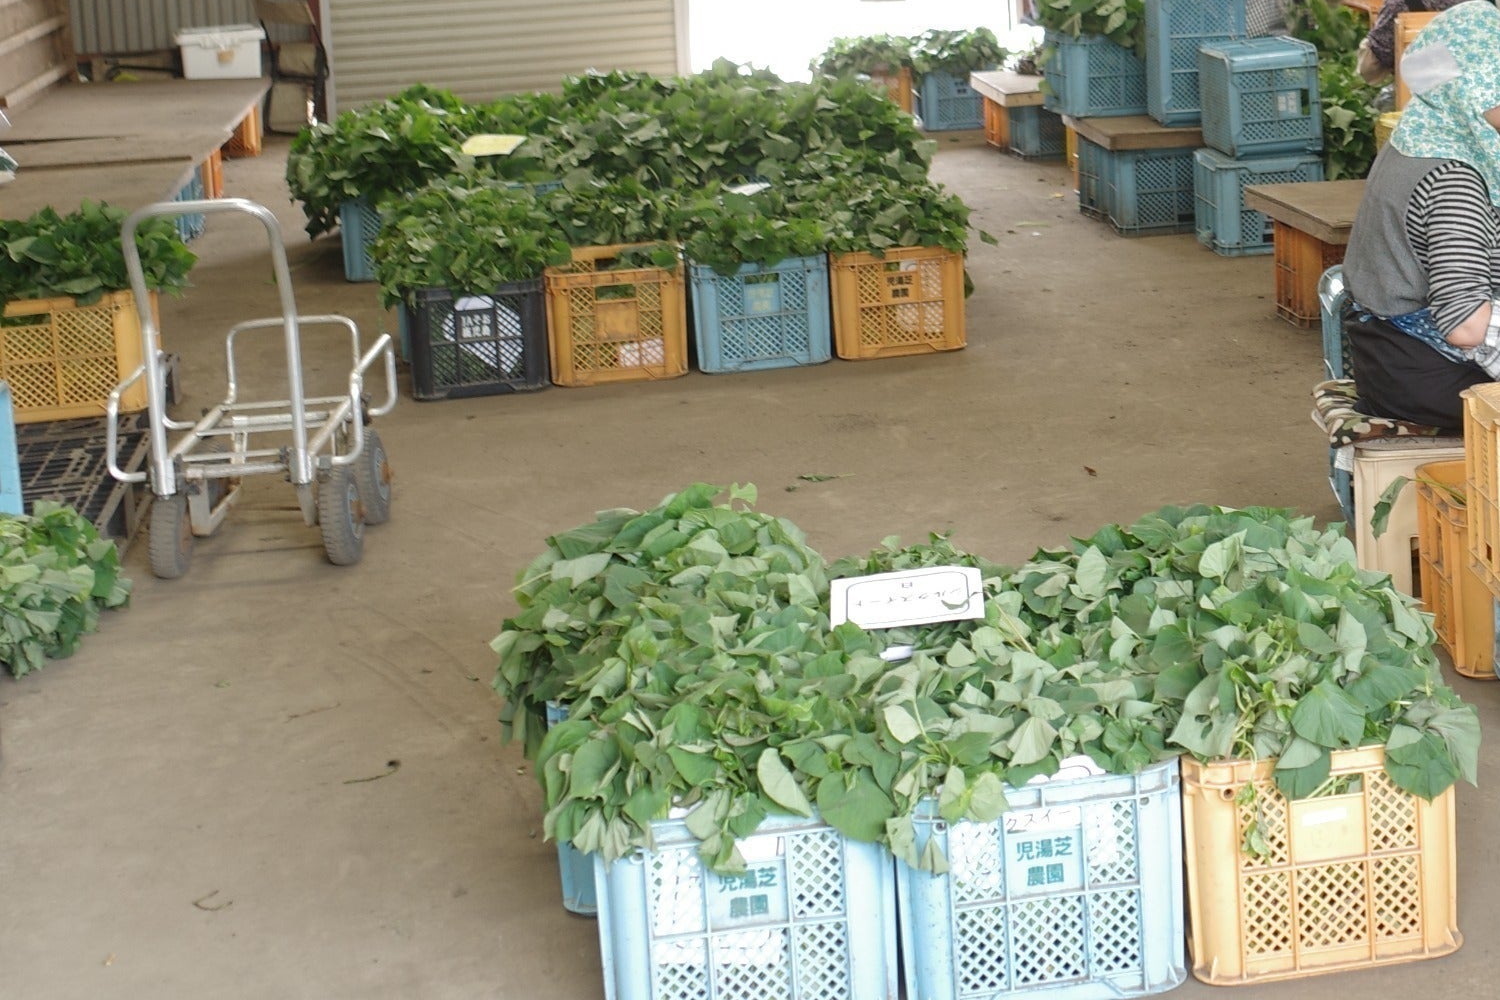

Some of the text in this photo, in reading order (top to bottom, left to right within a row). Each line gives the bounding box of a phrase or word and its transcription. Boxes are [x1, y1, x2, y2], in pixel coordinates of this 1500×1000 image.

[1016, 836, 1073, 862] 児湯芝
[1027, 863, 1064, 887] 農園
